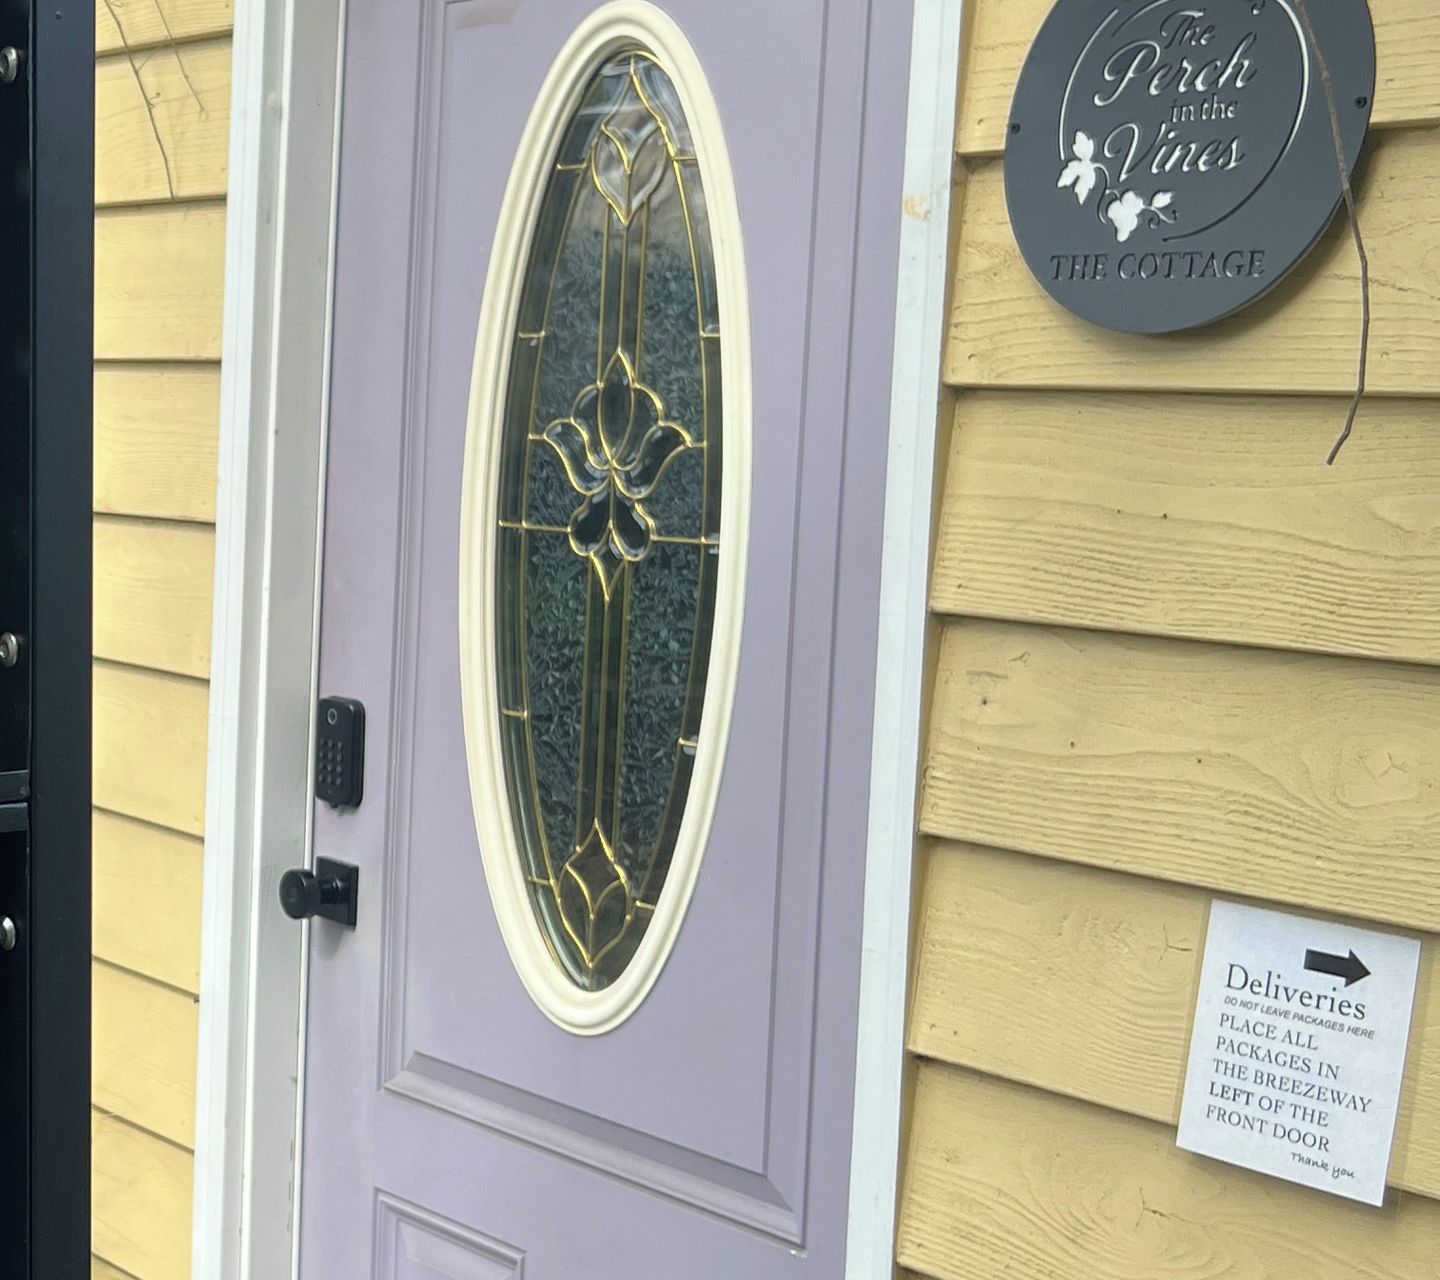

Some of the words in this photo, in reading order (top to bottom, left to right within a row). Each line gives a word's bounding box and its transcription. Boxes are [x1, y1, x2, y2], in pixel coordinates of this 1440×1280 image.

[1161, 8, 1214, 51] The
[1093, 31, 1258, 107] Perch
[1170, 96, 1194, 123] in
[1199, 93, 1241, 120] the
[1103, 122, 1245, 184] Vines
[1049, 253, 1108, 282] THE
[1116, 249, 1266, 281] COTTAGE
[1225, 962, 1366, 1021] Deliveries
[1218, 1012, 1277, 1041] PLACE
[1281, 1028, 1319, 1051] ALL
[1223, 995, 1239, 1007] DO
[1238, 999, 1260, 1012] NOT
[1260, 1004, 1291, 1020] LEAVE
[1292, 1012, 1345, 1033] PACKAGES
[1346, 1025, 1376, 1041] HERE
[1215, 1035, 1311, 1074] PACKAGES
[1317, 1061, 1340, 1081] IN
[1209, 1081, 1254, 1107] LEFT
[1258, 1095, 1285, 1115] OF
[1289, 1103, 1329, 1128] THE
[1212, 1058, 1248, 1082] THE
[1252, 1069, 1373, 1114] BREEZEWAY
[1206, 1103, 1268, 1135] FRONT
[1272, 1122, 1330, 1153] DOOR
[1290, 1152, 1329, 1172] Thank
[1332, 1165, 1356, 1180] you
